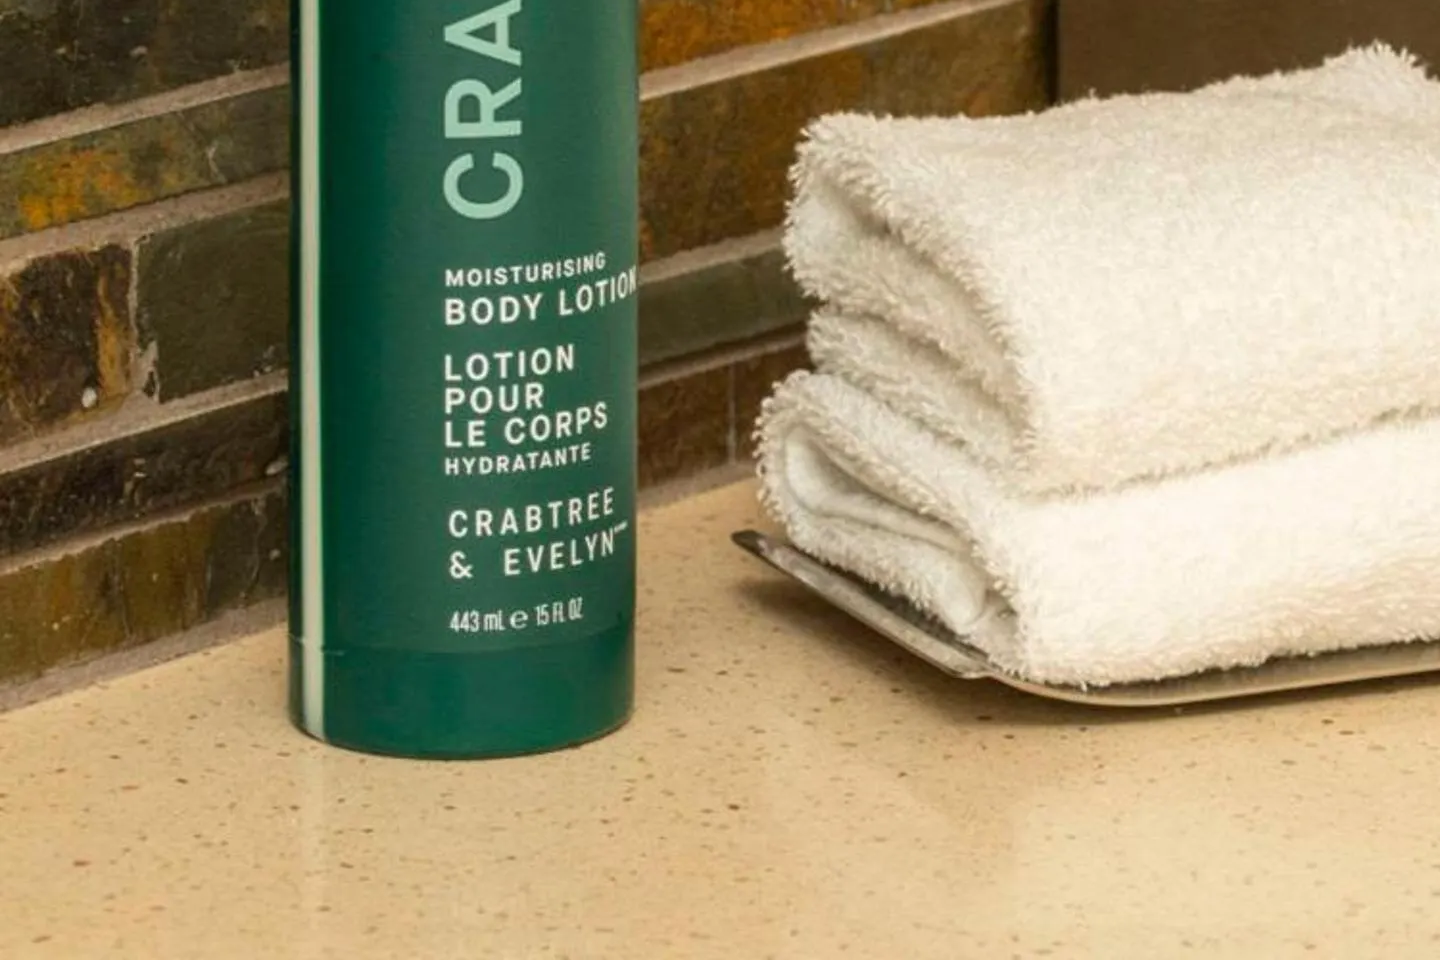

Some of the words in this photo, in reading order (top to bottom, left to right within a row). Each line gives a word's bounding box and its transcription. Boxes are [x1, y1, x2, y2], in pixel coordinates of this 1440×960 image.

[444, 251, 607, 288] MOISTURISING
[444, 292, 544, 326] BODY
[558, 265, 637, 317] LOTION
[444, 343, 575, 382] LOTION
[444, 382, 544, 415] POUR
[444, 419, 487, 448] LE
[504, 400, 608, 445] CORPS
[444, 442, 592, 476] HYDRATANTE
[448, 486, 615, 538] CRABTREE
[449, 550, 474, 580] &
[503, 527, 615, 577] EVELYN
[449, 609, 480, 633] 443
[534, 603, 550, 626] 15
